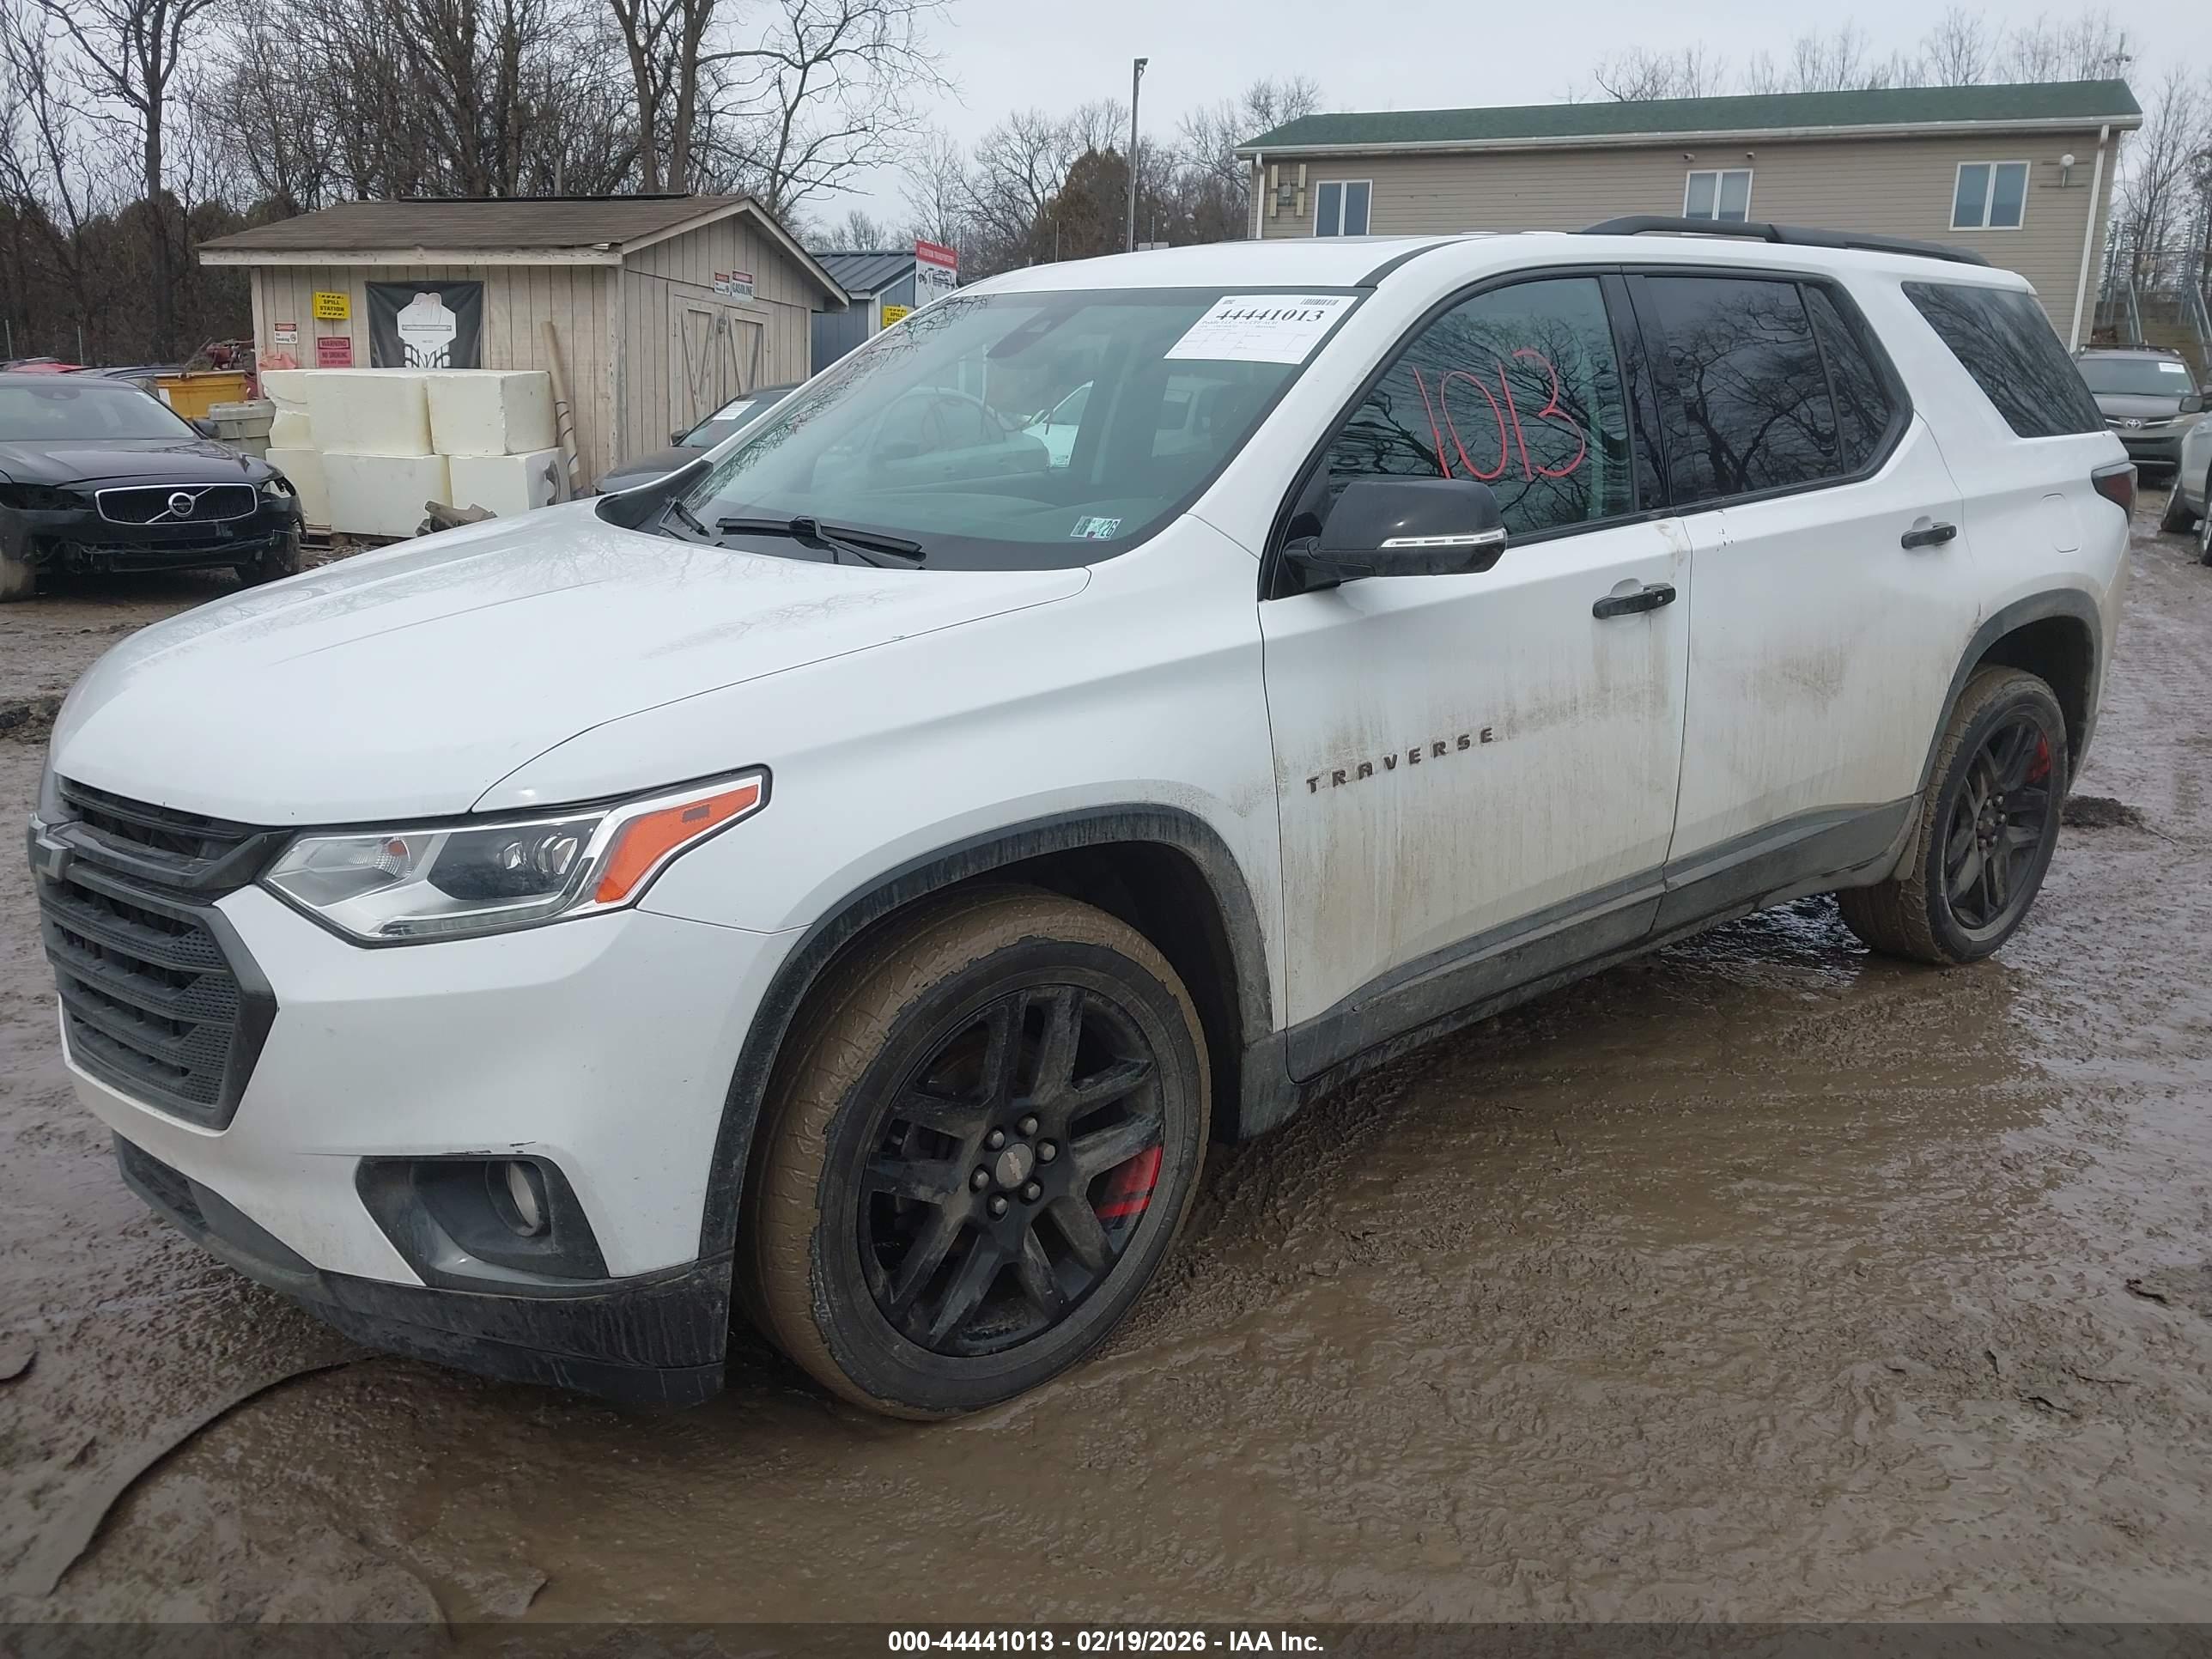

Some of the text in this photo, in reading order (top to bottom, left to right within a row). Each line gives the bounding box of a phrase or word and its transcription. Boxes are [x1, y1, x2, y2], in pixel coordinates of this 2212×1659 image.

[732, 282, 753, 296] GASOLINE
[1216, 308, 1325, 322] 44441013
[1413, 346, 1586, 481] 1013
[1306, 727, 1492, 794] TRAVERSE
